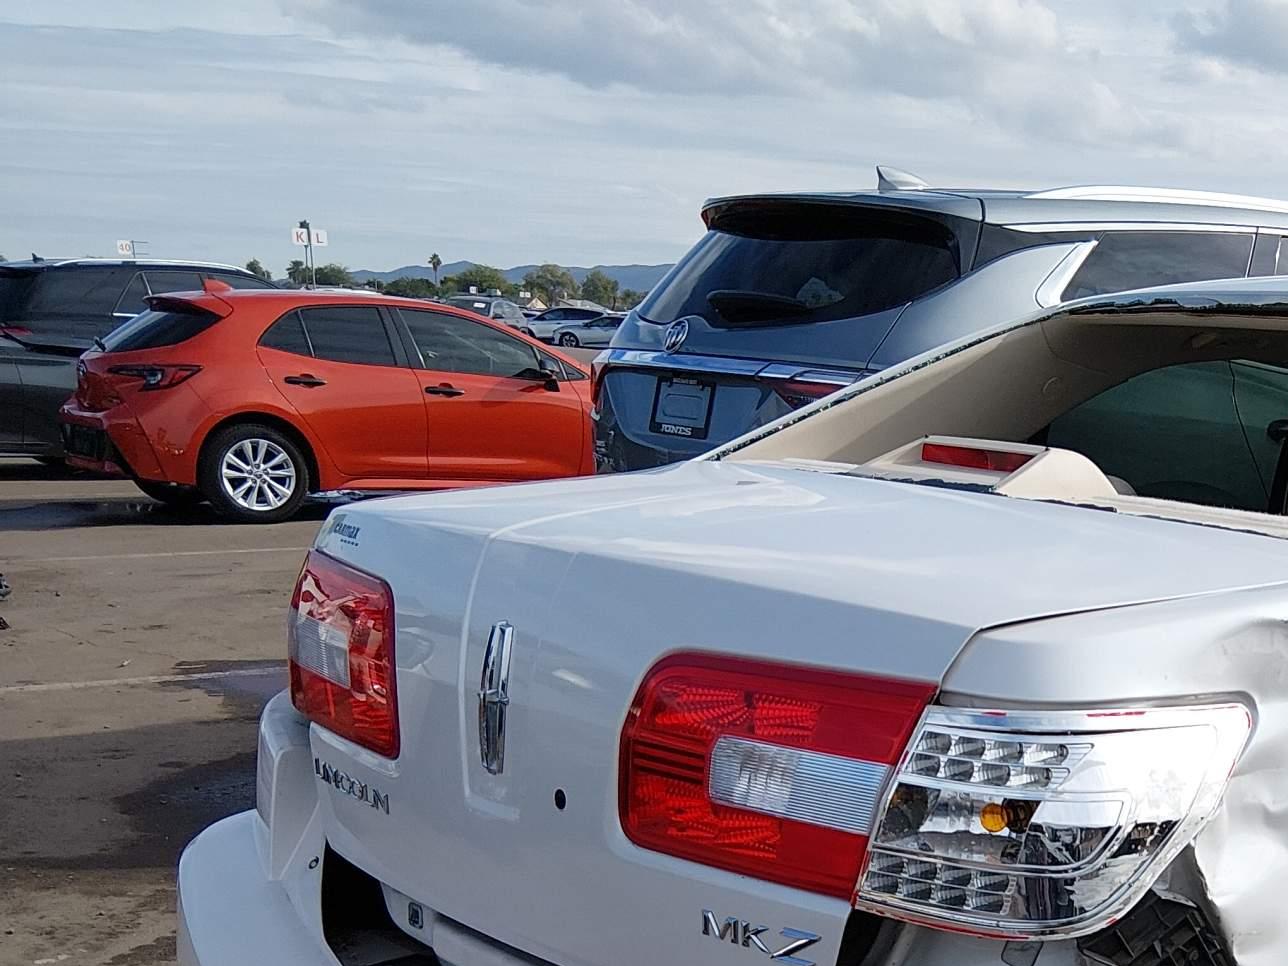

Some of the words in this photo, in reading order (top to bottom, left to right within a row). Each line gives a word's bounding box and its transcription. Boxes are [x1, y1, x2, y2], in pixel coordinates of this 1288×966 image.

[295, 231, 304, 243] K
[315, 233, 324, 245] L
[119, 242, 131, 253] 40
[314, 757, 390, 816] LINCOLN
